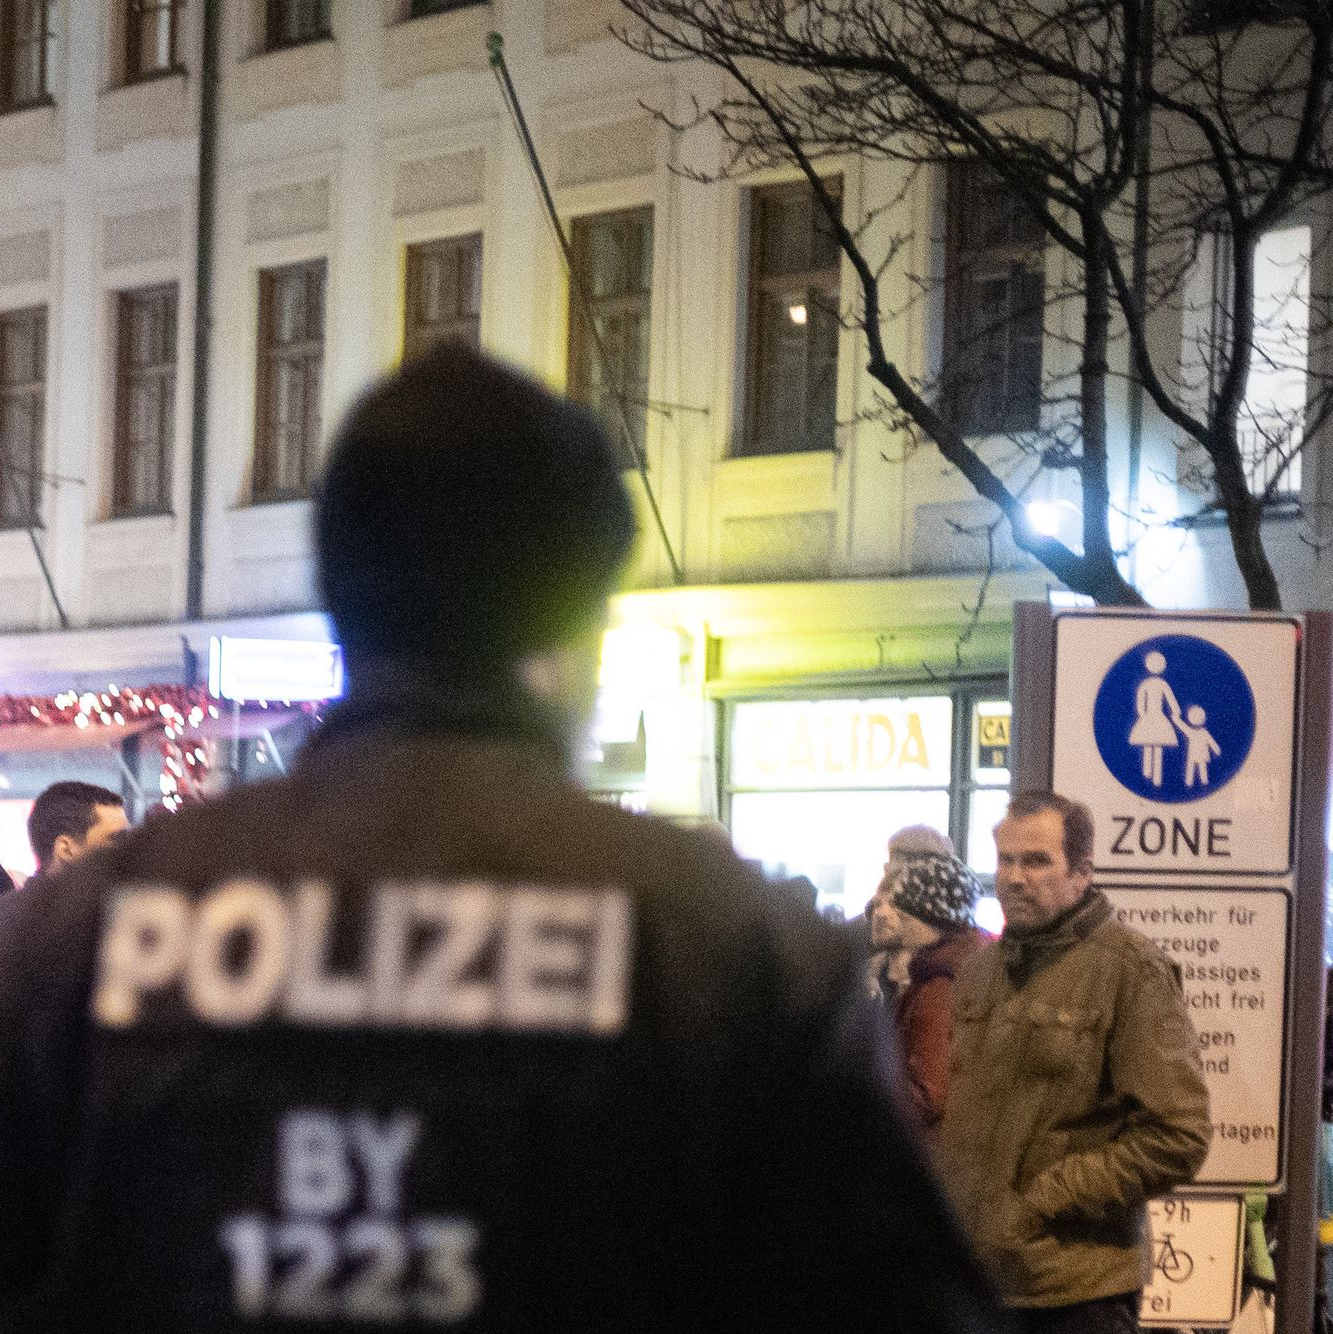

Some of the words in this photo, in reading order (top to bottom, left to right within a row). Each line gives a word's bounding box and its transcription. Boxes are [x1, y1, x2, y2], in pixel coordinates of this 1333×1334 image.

[753, 712, 931, 774] CALIDA
[1111, 815, 1232, 857] ZONE
[1229, 906, 1257, 924] für
[93, 879, 632, 1034] POLIZEI
[1231, 990, 1266, 1010] frei
[278, 1109, 422, 1218] BY
[219, 1214, 481, 1321] 1223
